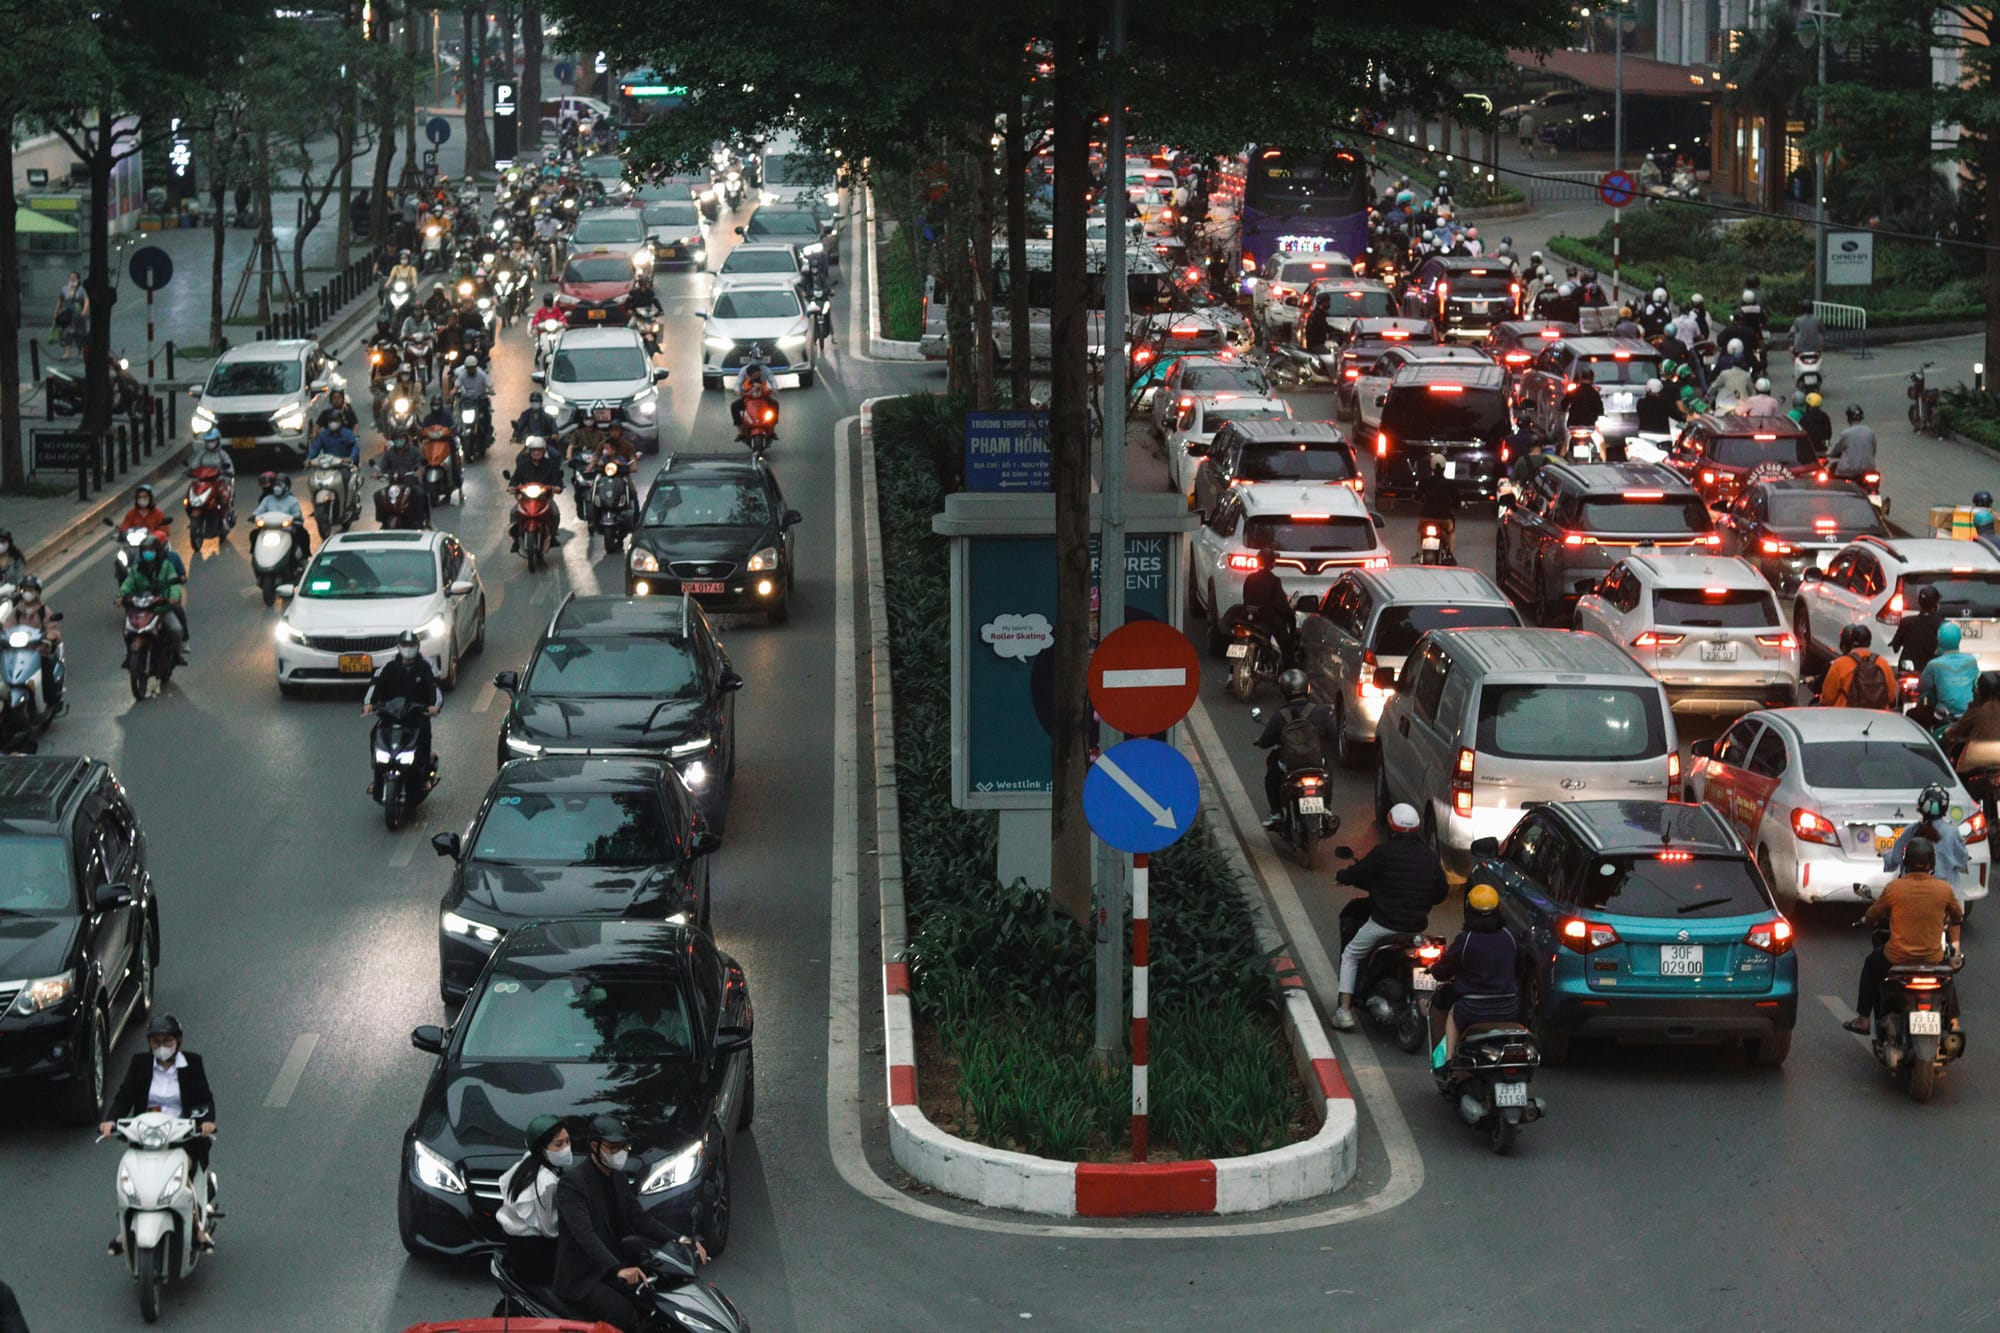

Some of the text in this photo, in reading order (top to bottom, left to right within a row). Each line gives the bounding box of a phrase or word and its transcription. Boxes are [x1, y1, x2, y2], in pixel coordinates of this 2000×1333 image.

[498, 85, 512, 103] P
[971, 437, 1010, 457] PHẠM
[991, 632, 1046, 641] Roller Skating
[996, 780, 1041, 789] Westlink
[1671, 947, 1693, 959] 30F
[1662, 961, 1702, 975] 029.00
[1498, 1094, 1526, 1105] 211.50
